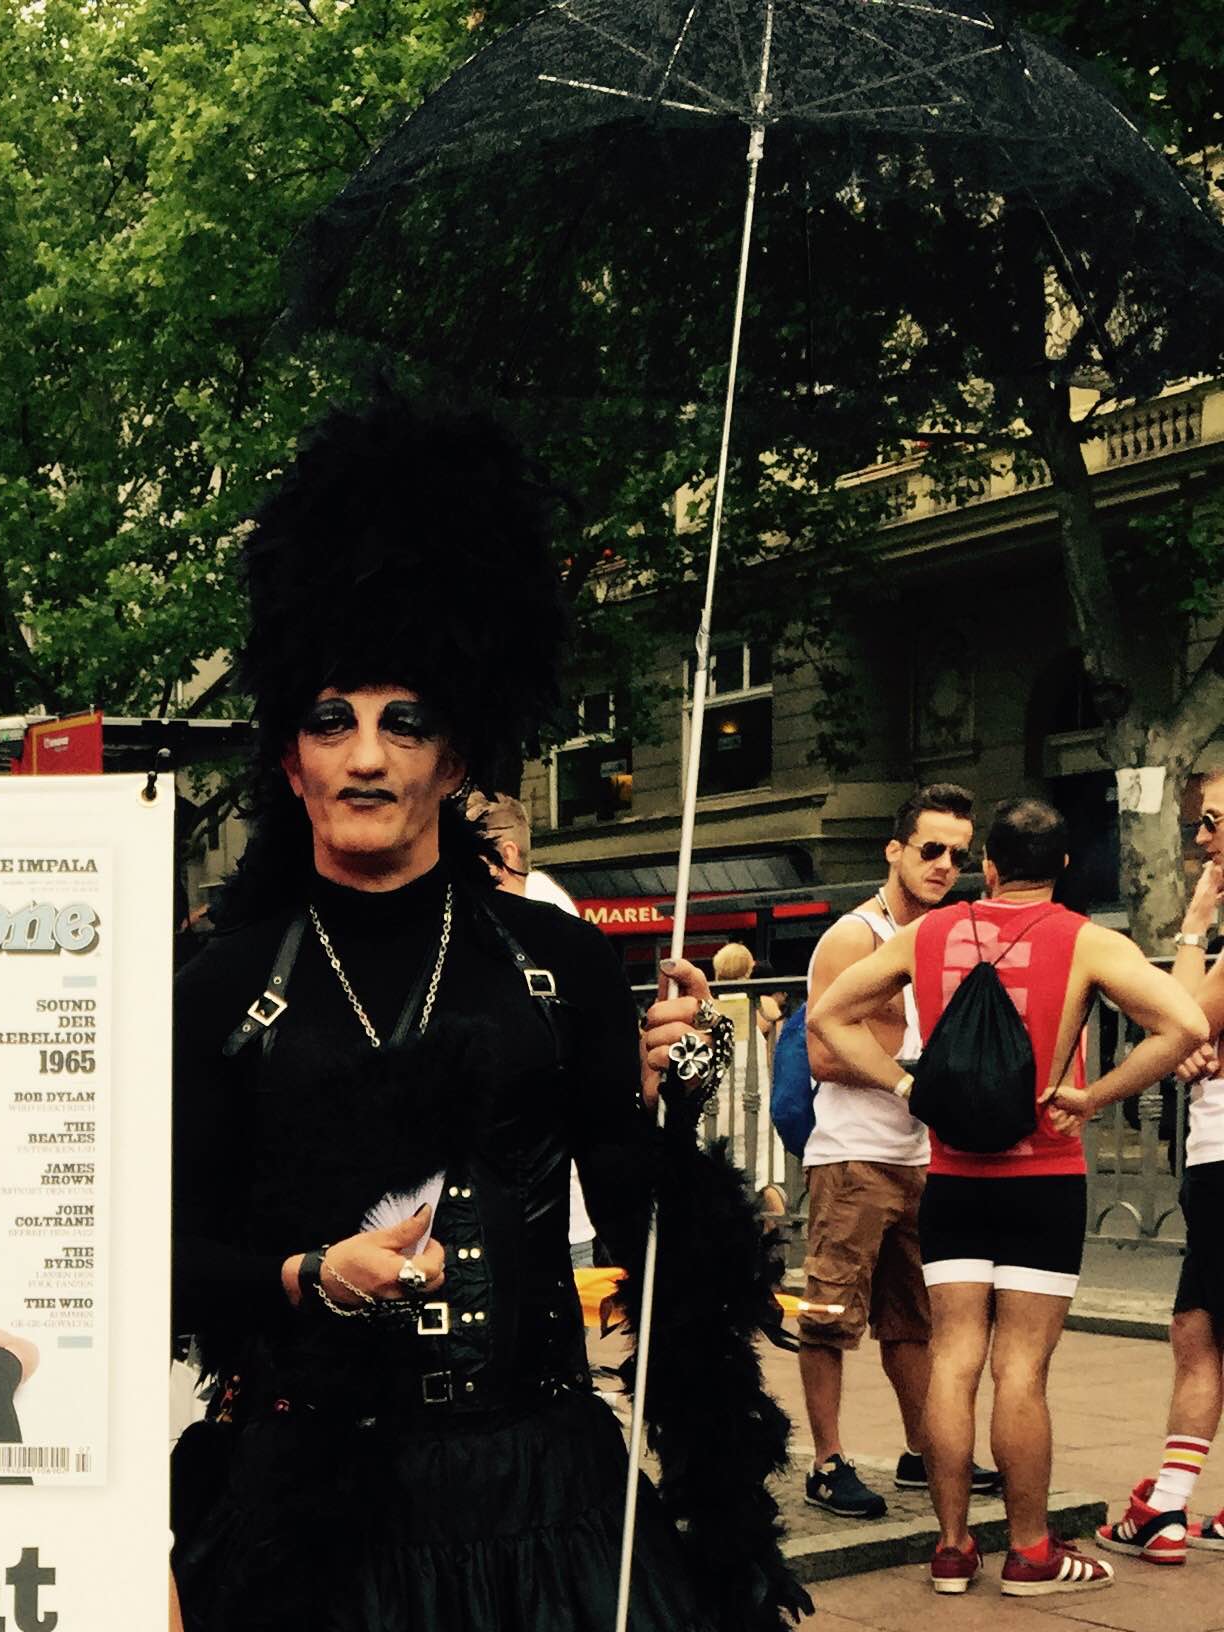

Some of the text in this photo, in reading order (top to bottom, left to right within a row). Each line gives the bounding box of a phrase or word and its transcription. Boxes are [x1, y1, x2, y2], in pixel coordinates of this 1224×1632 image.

[17, 858, 98, 873] IMPALA
[36, 1000, 97, 1012] SOUND
[58, 1016, 96, 1028] DER
[39, 1049, 96, 1075] 1965
[14, 1092, 95, 1103] BOB DYLAN
[64, 1121, 96, 1132] THE
[28, 1133, 96, 1144] BEATLES
[44, 1163, 96, 1174] JAMES
[40, 1174, 95, 1186] BROWN
[56, 1205, 95, 1216] JOHN
[14, 1216, 95, 1227] COLTRANE
[62, 1246, 94, 1257] THE
[44, 1258, 94, 1270] BYRDS
[23, 1297, 94, 1309] THE WHO
